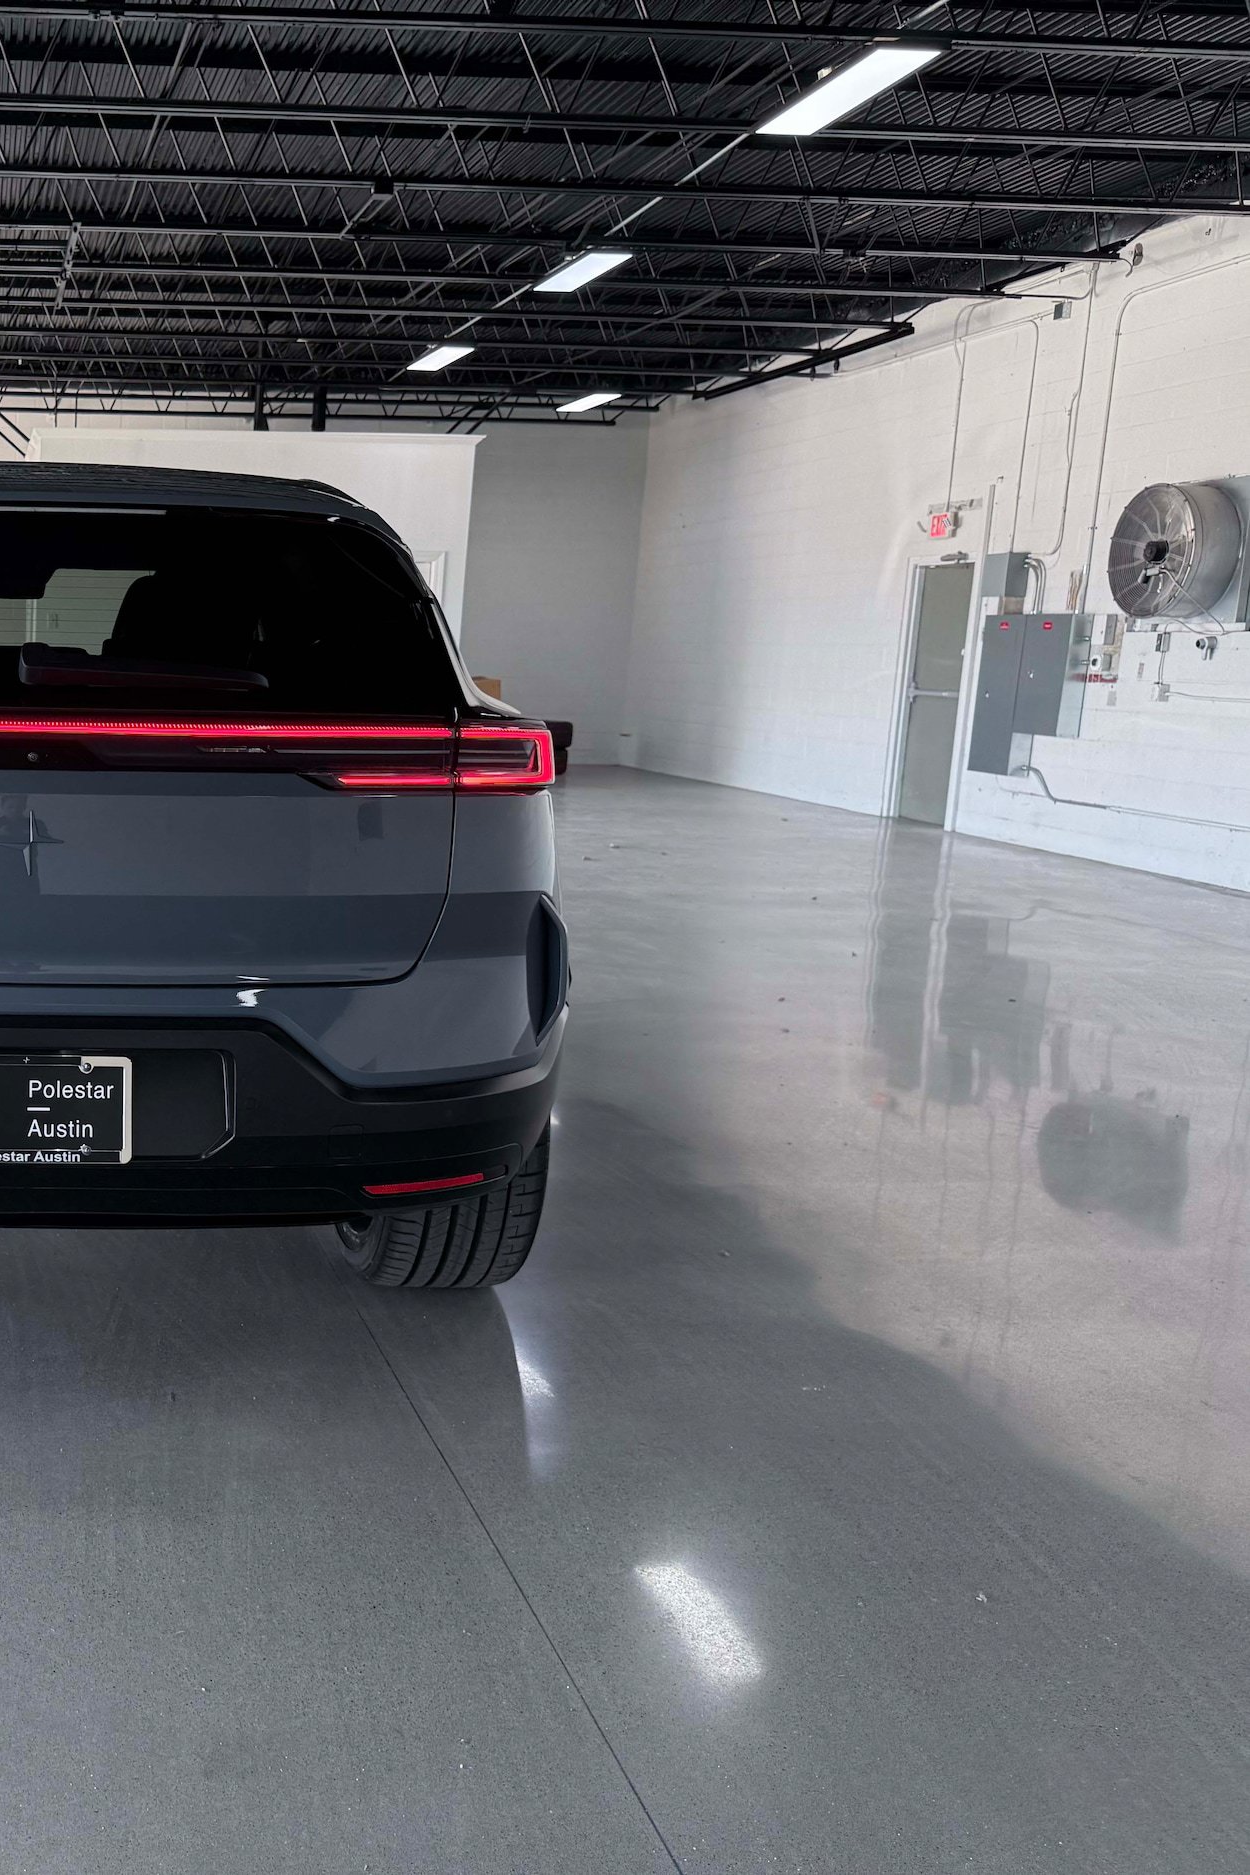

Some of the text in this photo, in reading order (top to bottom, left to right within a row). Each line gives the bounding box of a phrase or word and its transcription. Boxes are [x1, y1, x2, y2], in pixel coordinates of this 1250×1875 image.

[28, 1079, 114, 1099] Polestar
[27, 1119, 94, 1138] Austin
[34, 1150, 81, 1162] Austin
